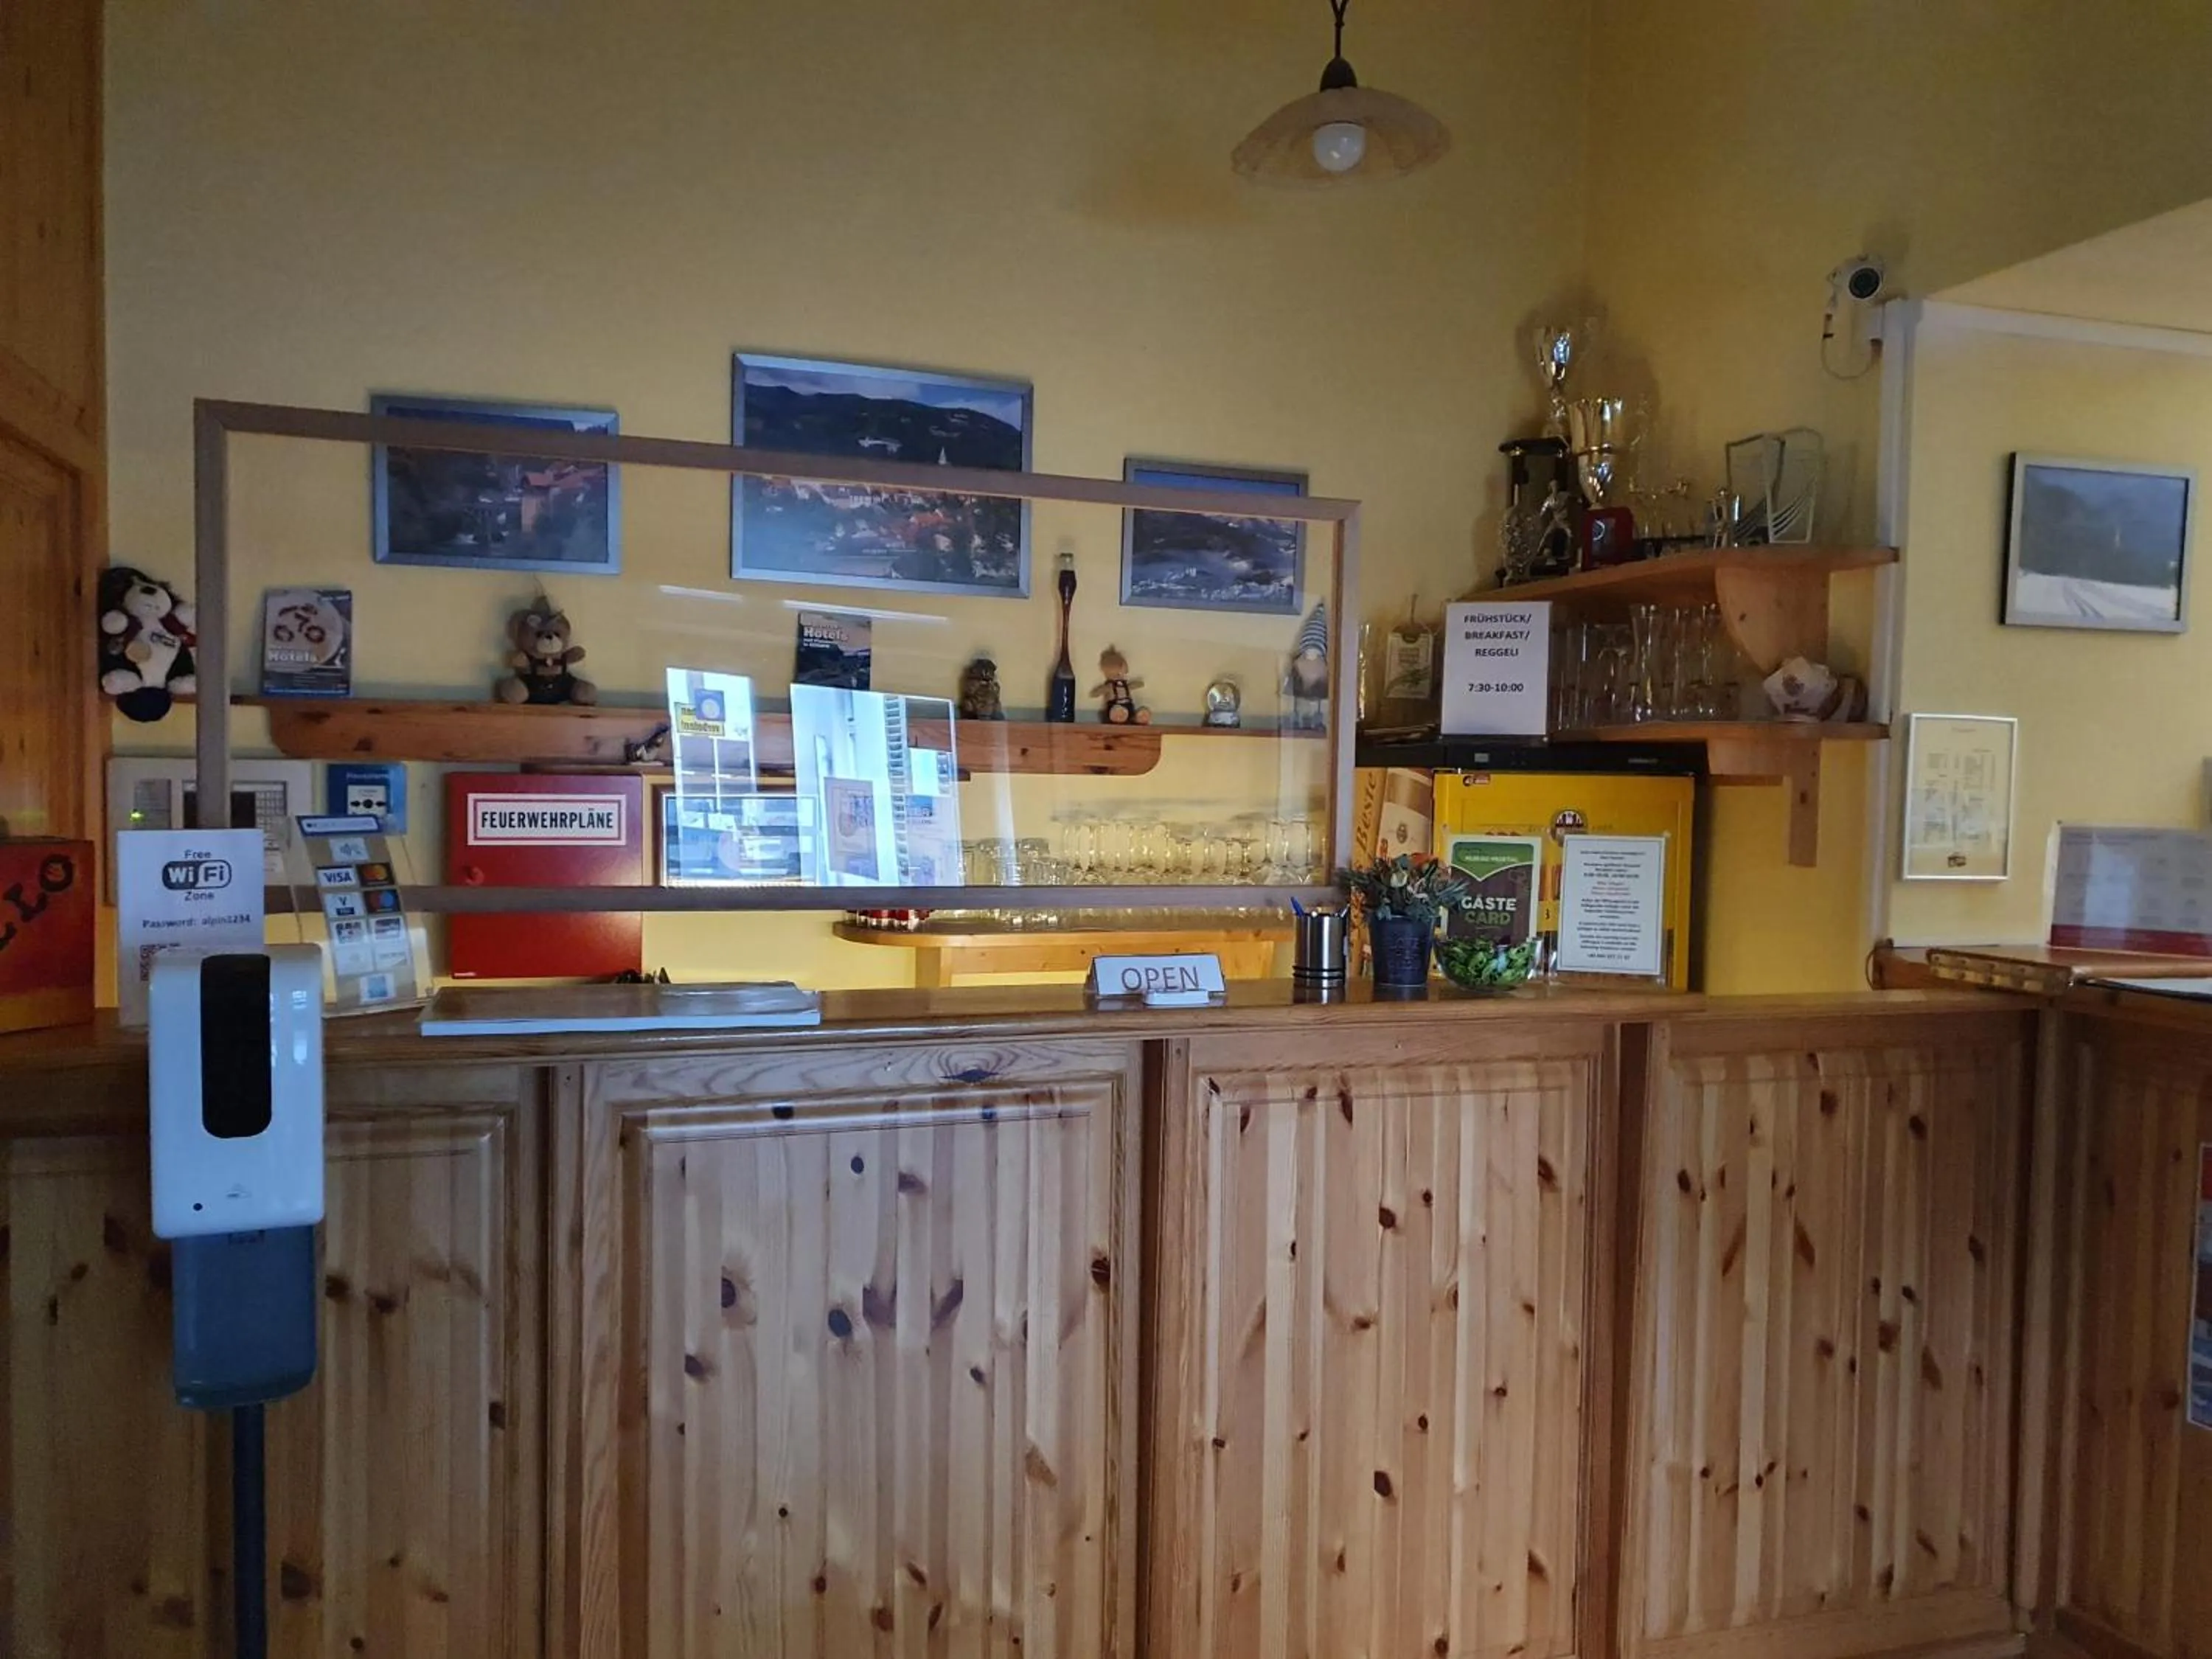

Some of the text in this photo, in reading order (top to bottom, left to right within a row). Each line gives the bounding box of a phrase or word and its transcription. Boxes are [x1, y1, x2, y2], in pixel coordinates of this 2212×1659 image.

[1464, 613, 1531, 624] FRÜHSTÜCK/
[1464, 630, 1530, 641] BREAKFAST/
[1475, 648, 1519, 657] REGGELI
[1468, 682, 1524, 692] 7:30-10:00
[481, 807, 613, 829] FEUERWEHRPLÄNE
[184, 849, 212, 859] Free
[323, 871, 352, 883] VISA
[184, 891, 215, 901] Zone
[1464, 911, 1512, 925] CARD
[1121, 965, 1200, 992] OPEN
